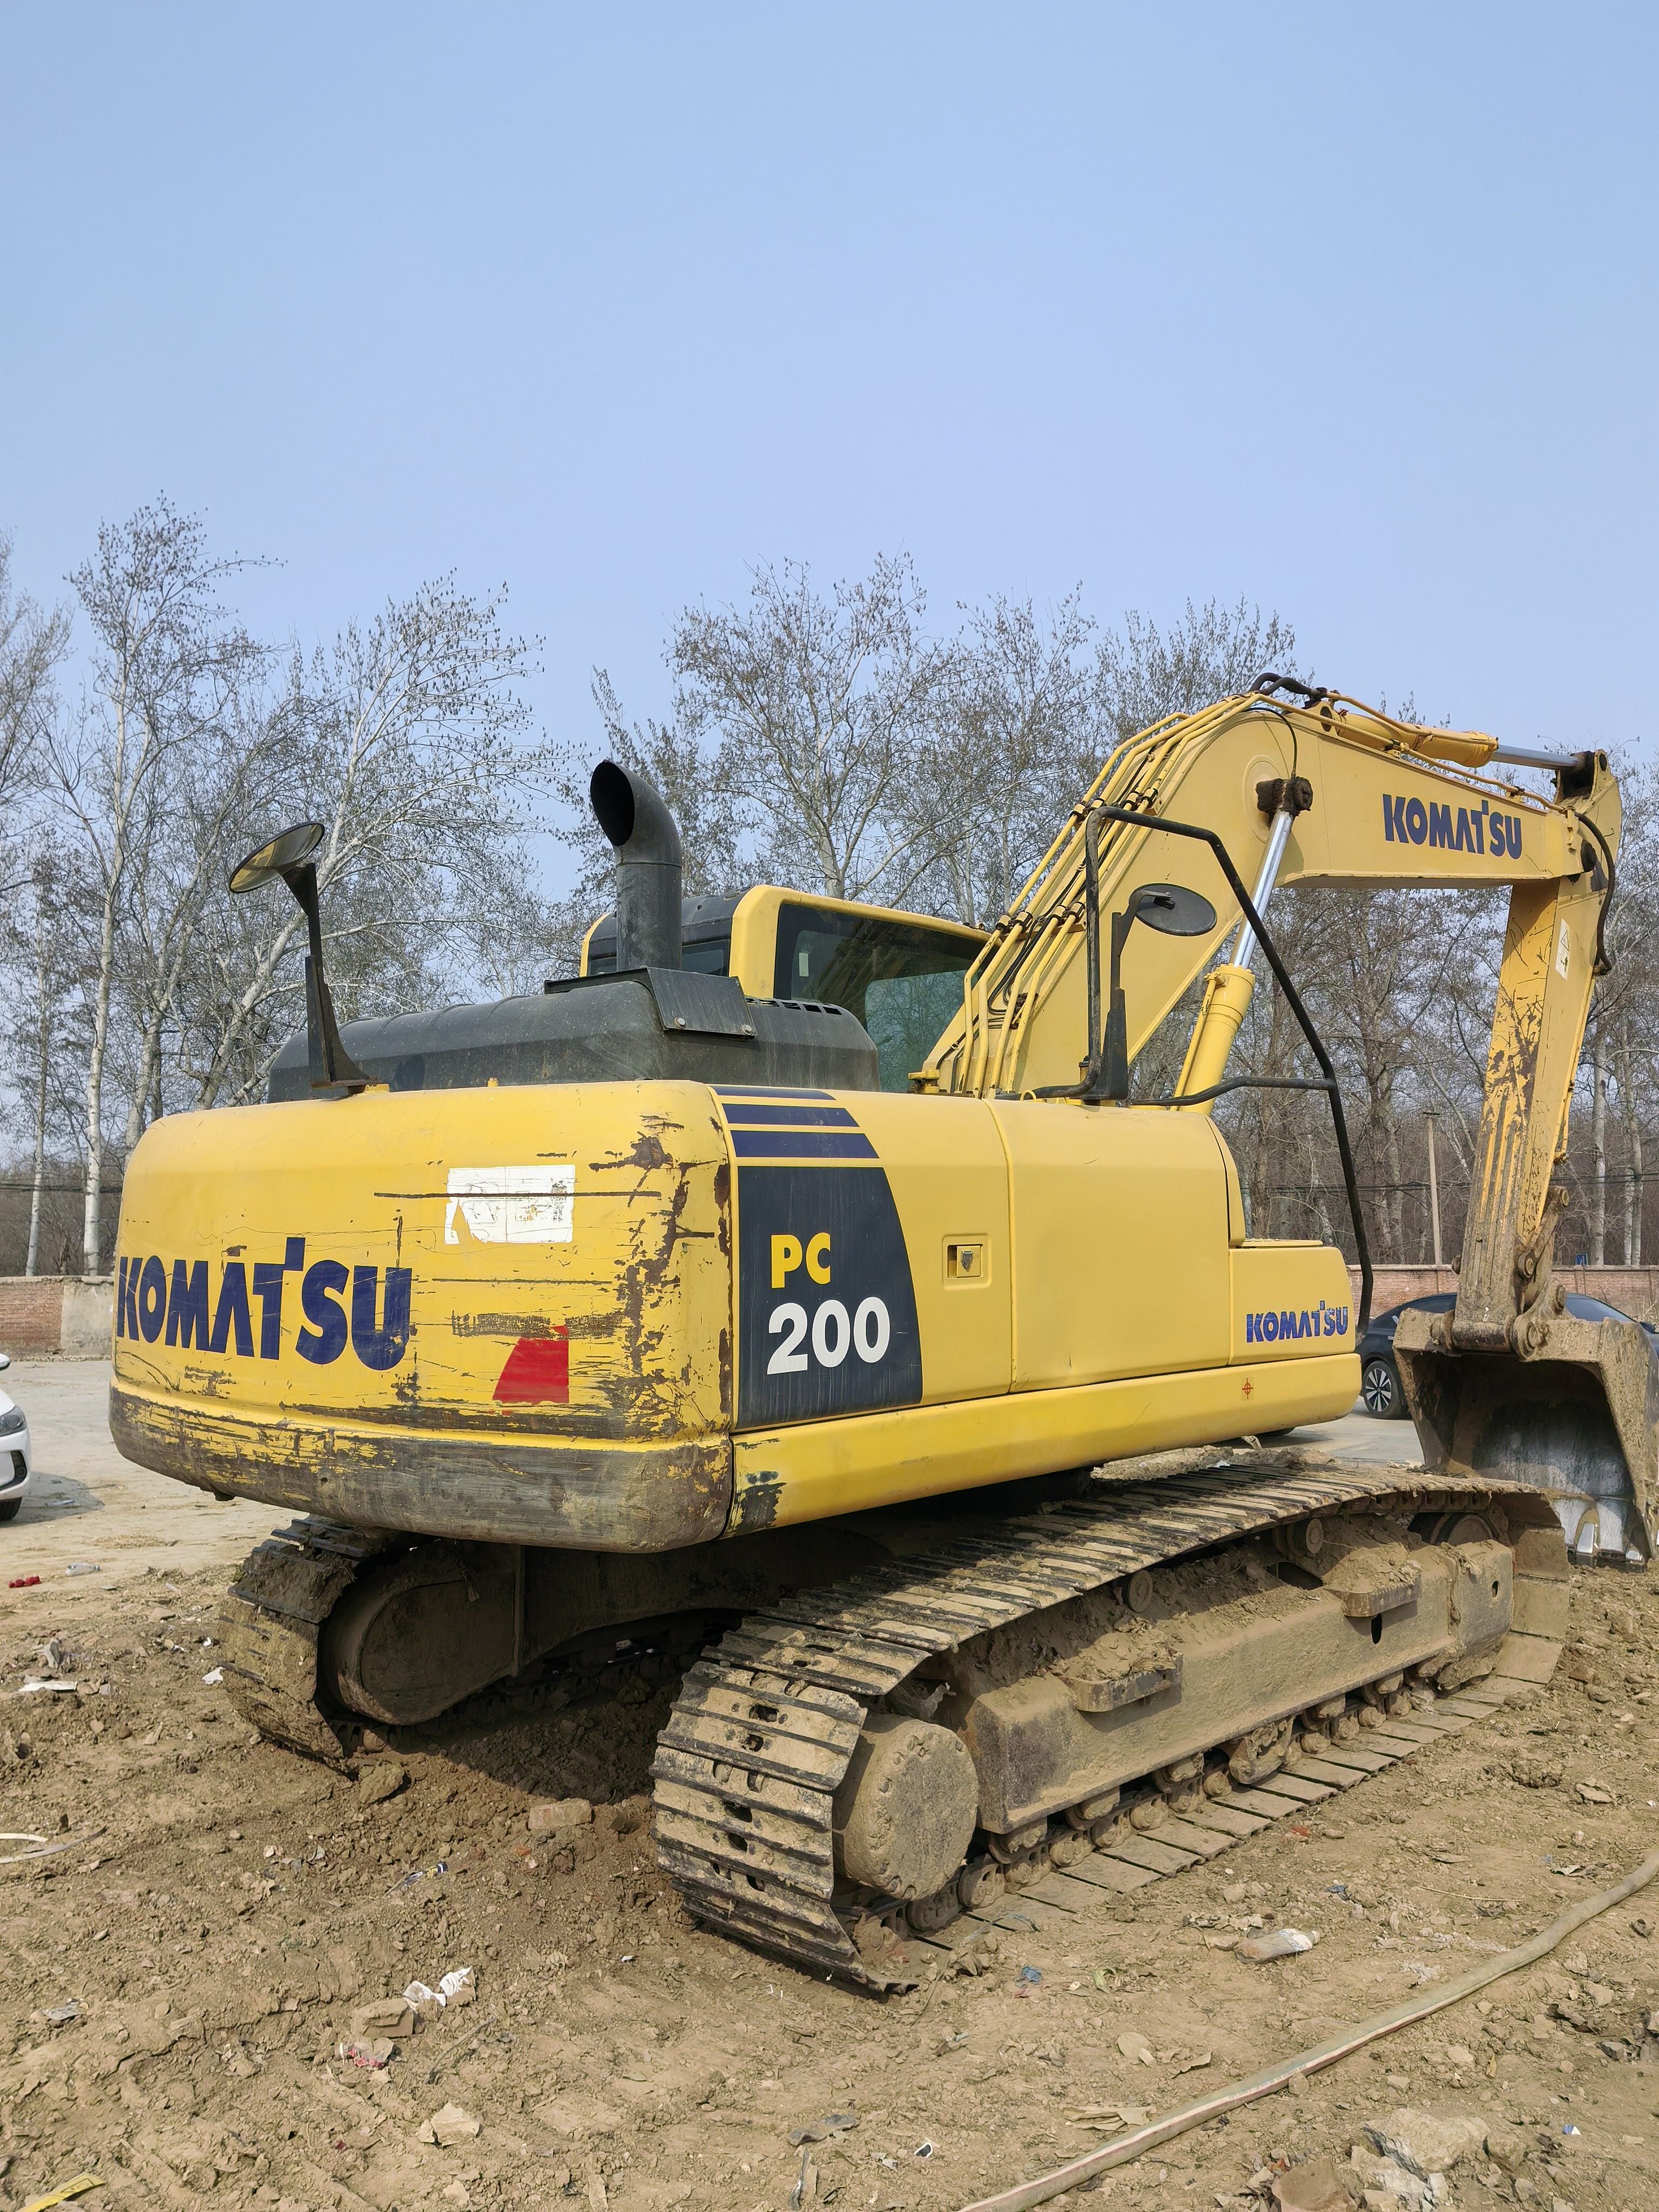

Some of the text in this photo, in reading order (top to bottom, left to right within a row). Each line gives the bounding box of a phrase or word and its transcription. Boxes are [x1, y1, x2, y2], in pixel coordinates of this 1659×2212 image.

[1382, 794, 1522, 859] KOMATSU
[771, 1232, 831, 1288] PC
[117, 1237, 412, 1370] KOMATSU
[767, 1297, 890, 1374] 200
[1246, 1300, 1348, 1343] KOMATSU
